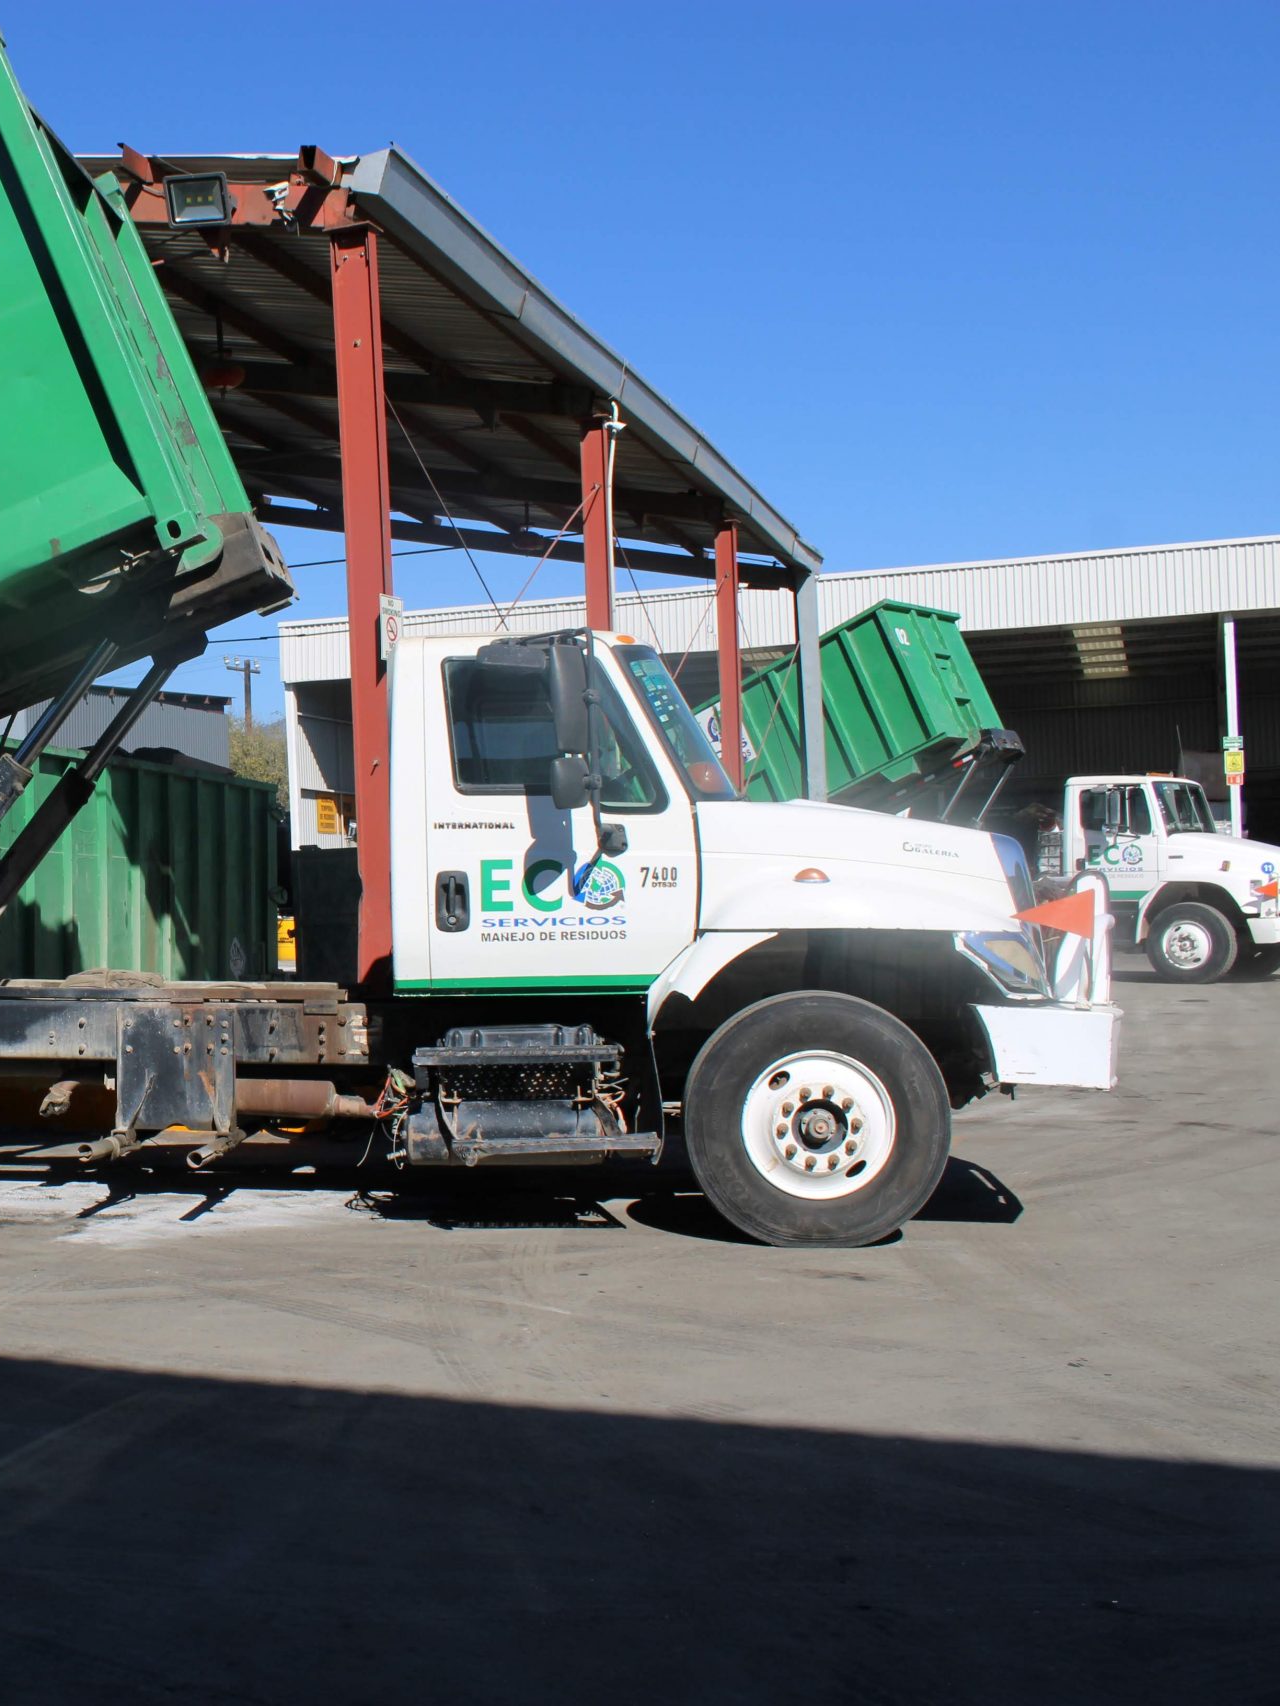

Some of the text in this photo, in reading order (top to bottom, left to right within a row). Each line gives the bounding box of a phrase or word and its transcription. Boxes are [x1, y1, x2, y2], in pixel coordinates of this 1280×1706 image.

[433, 822, 515, 830] INTERNATIONAL
[1263, 864, 1273, 872] 11
[640, 866, 678, 888] 7400
[481, 915, 627, 928] SERVICIOS
[481, 930, 627, 943] MANEJO DE RESIDUOS
